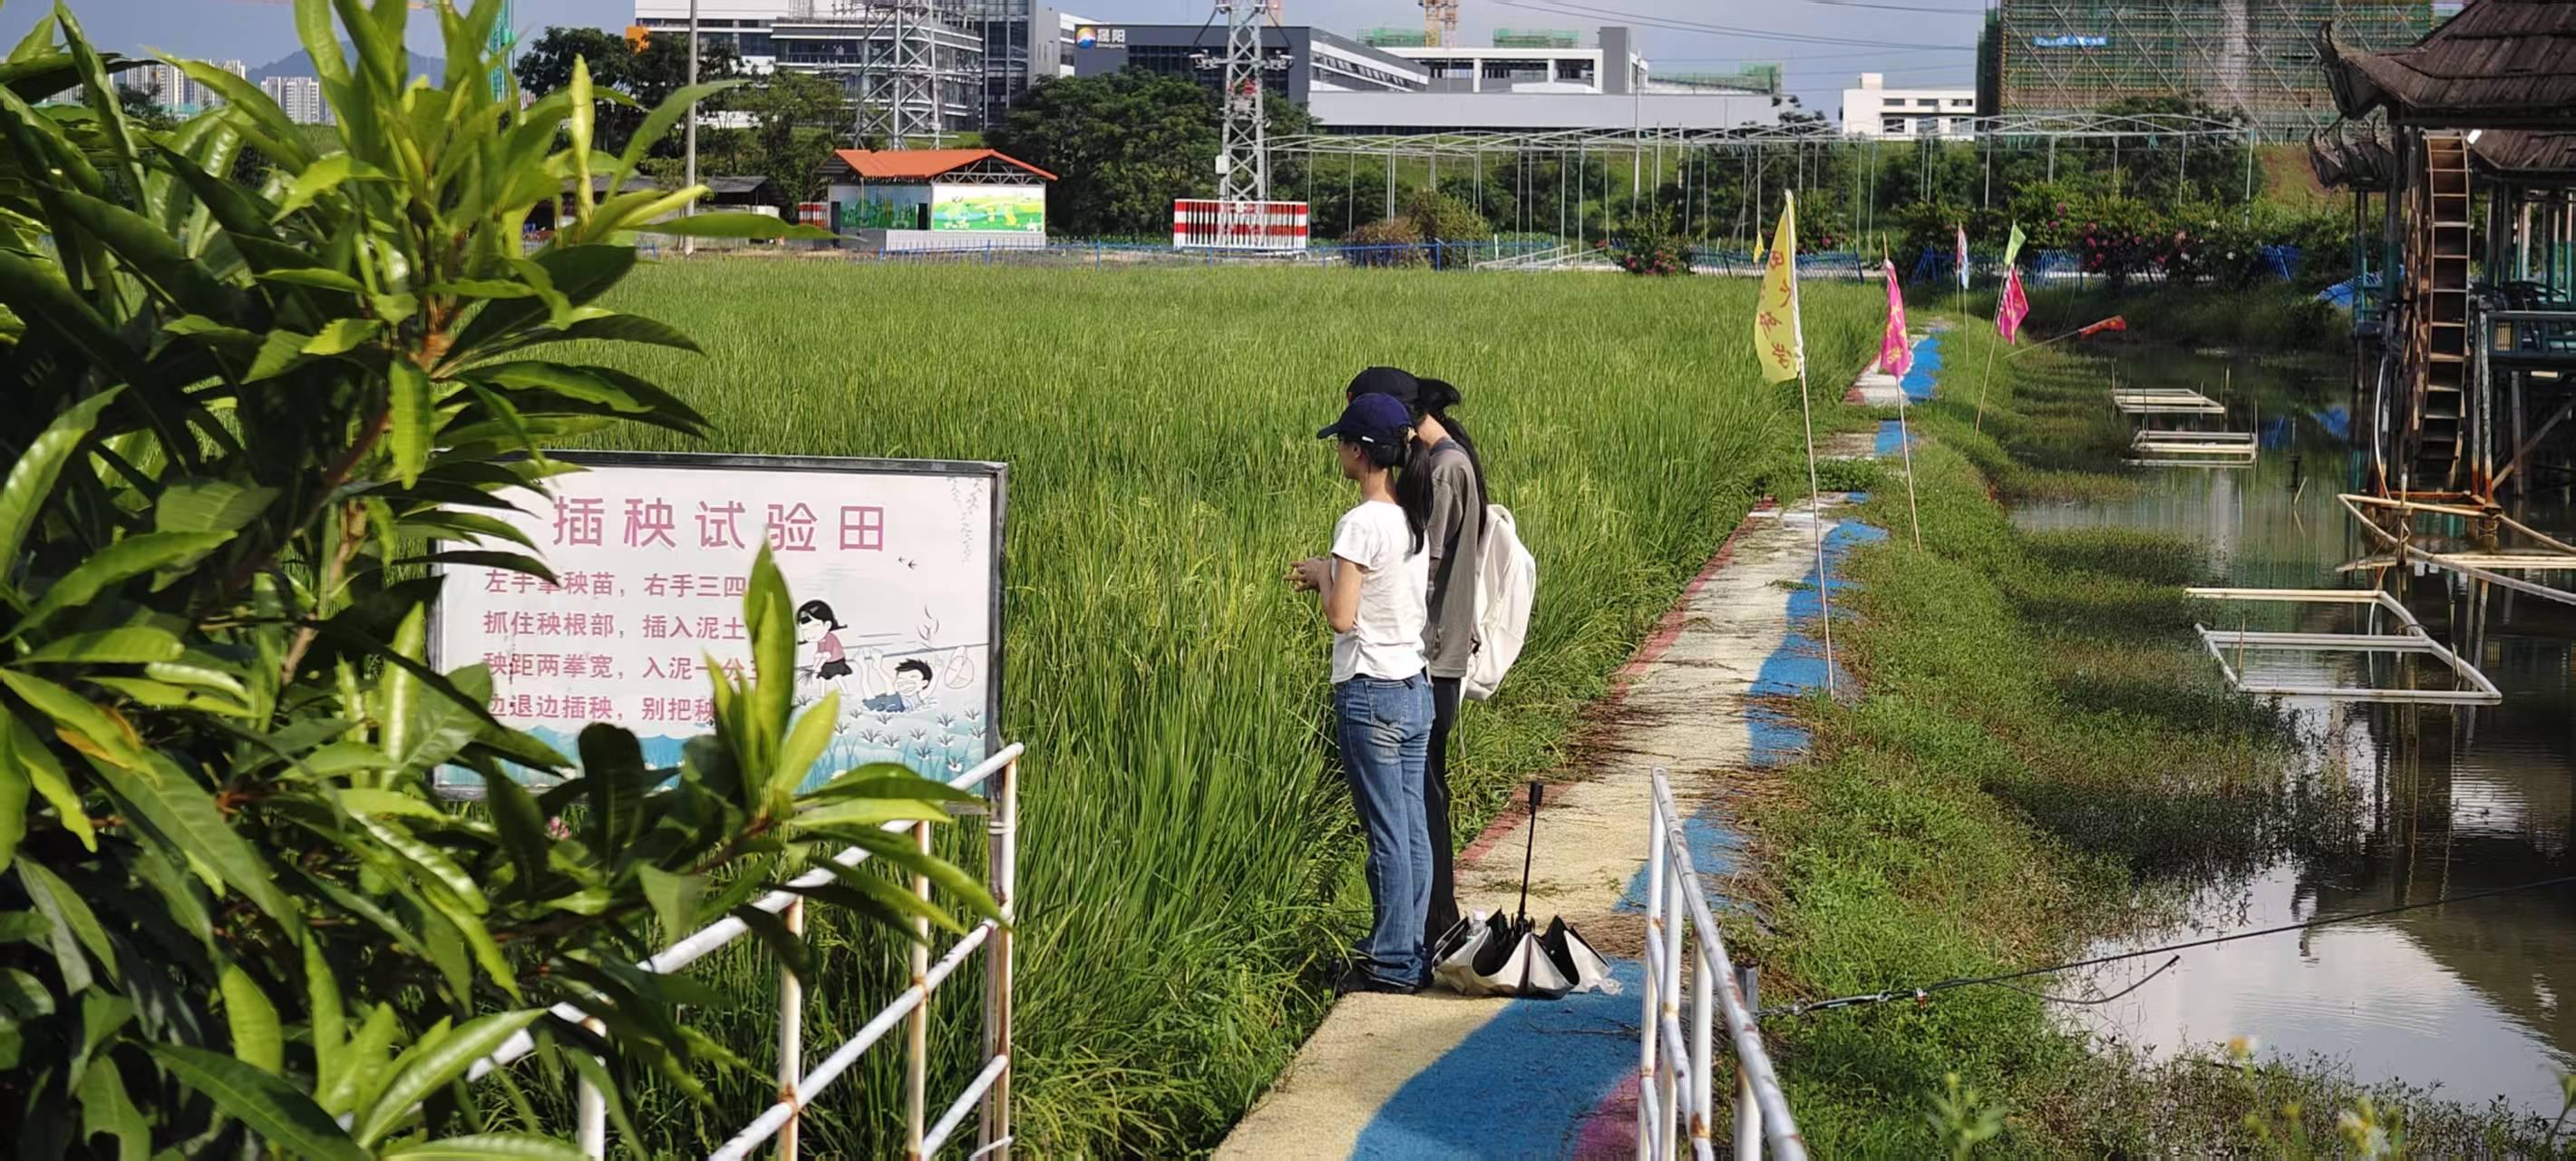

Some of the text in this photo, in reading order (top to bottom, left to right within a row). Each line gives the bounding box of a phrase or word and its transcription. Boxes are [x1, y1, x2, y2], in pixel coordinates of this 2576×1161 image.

[553, 495, 884, 552] 插秧试验田
[483, 610, 746, 640] 抓住秧根部，插入泥土
